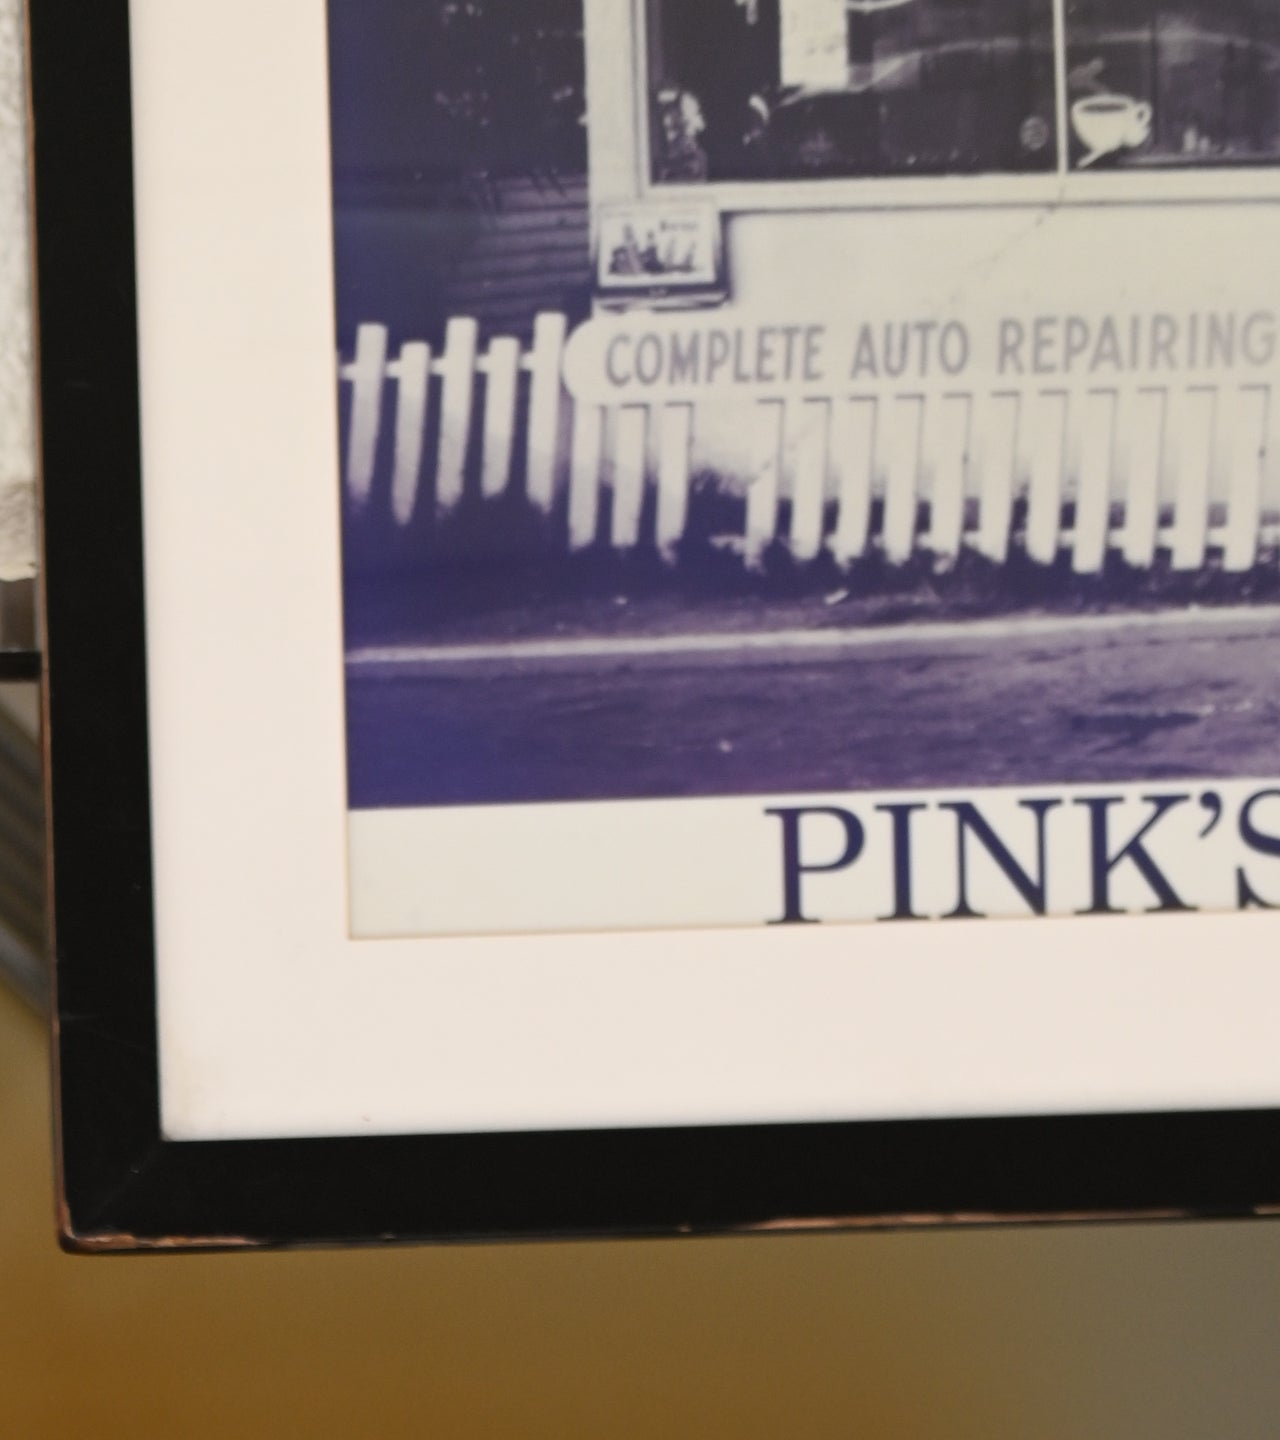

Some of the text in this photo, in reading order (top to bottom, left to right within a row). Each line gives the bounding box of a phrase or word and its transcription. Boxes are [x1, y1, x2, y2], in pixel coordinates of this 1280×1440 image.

[606, 310, 1278, 388] COMPLETE AUTO REPAIRING
[764, 788, 1280, 925] PINK'S
